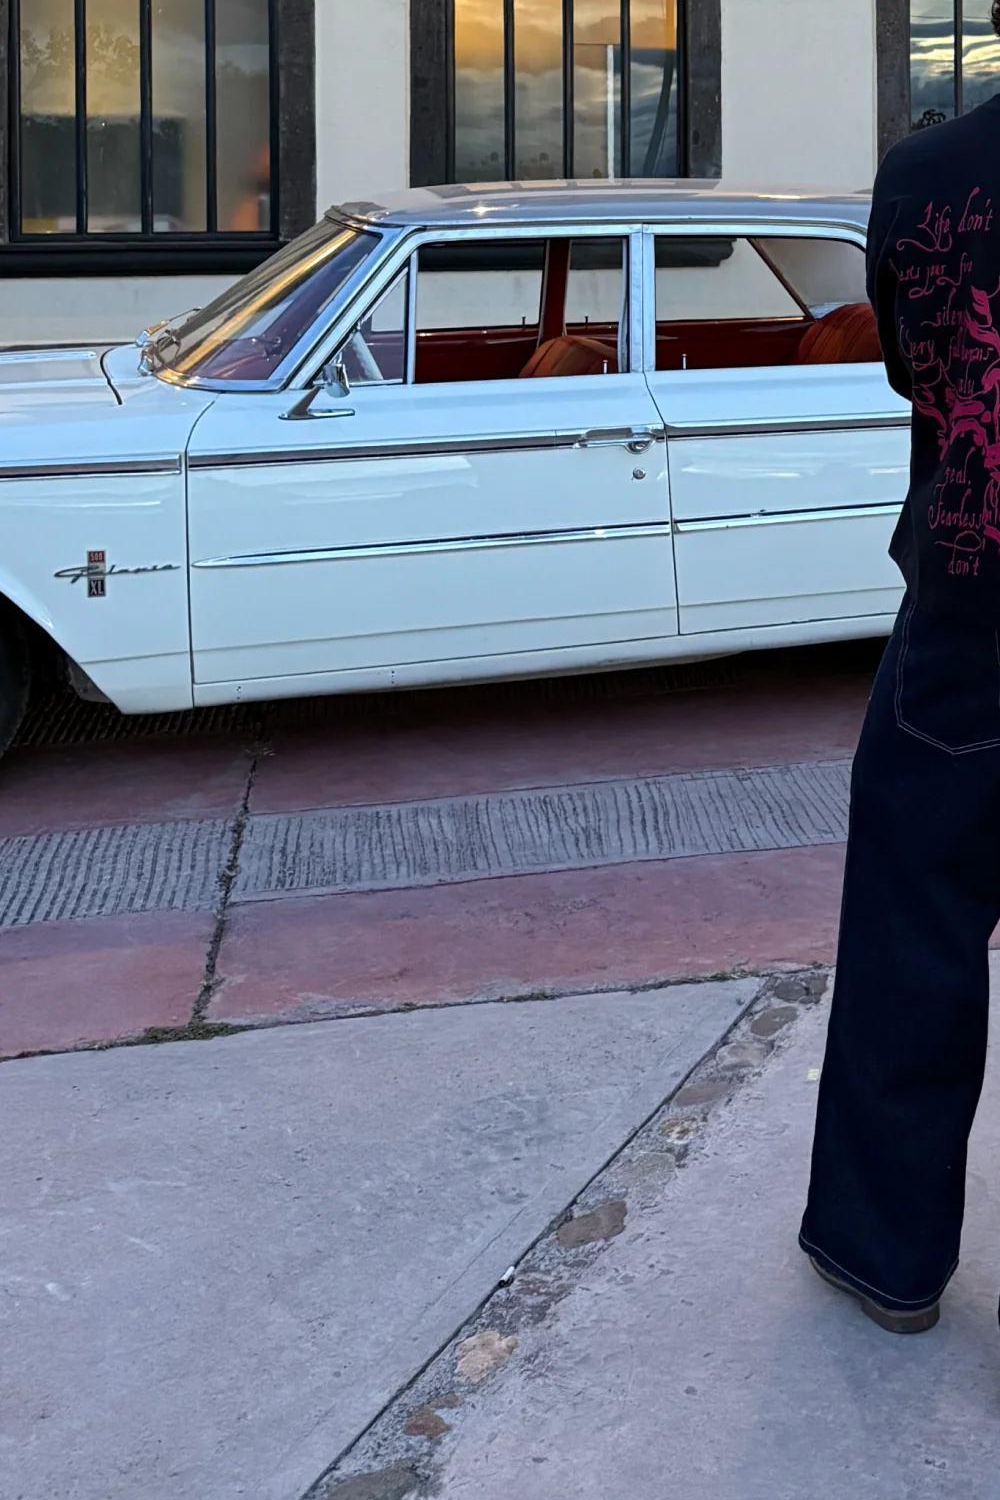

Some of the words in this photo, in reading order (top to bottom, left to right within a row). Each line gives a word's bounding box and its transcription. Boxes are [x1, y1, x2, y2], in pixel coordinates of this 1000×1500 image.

[896, 200, 952, 252] Life
[958, 187, 993, 233] don't
[90, 552, 103, 561] 500
[90, 580, 104, 595] XL
